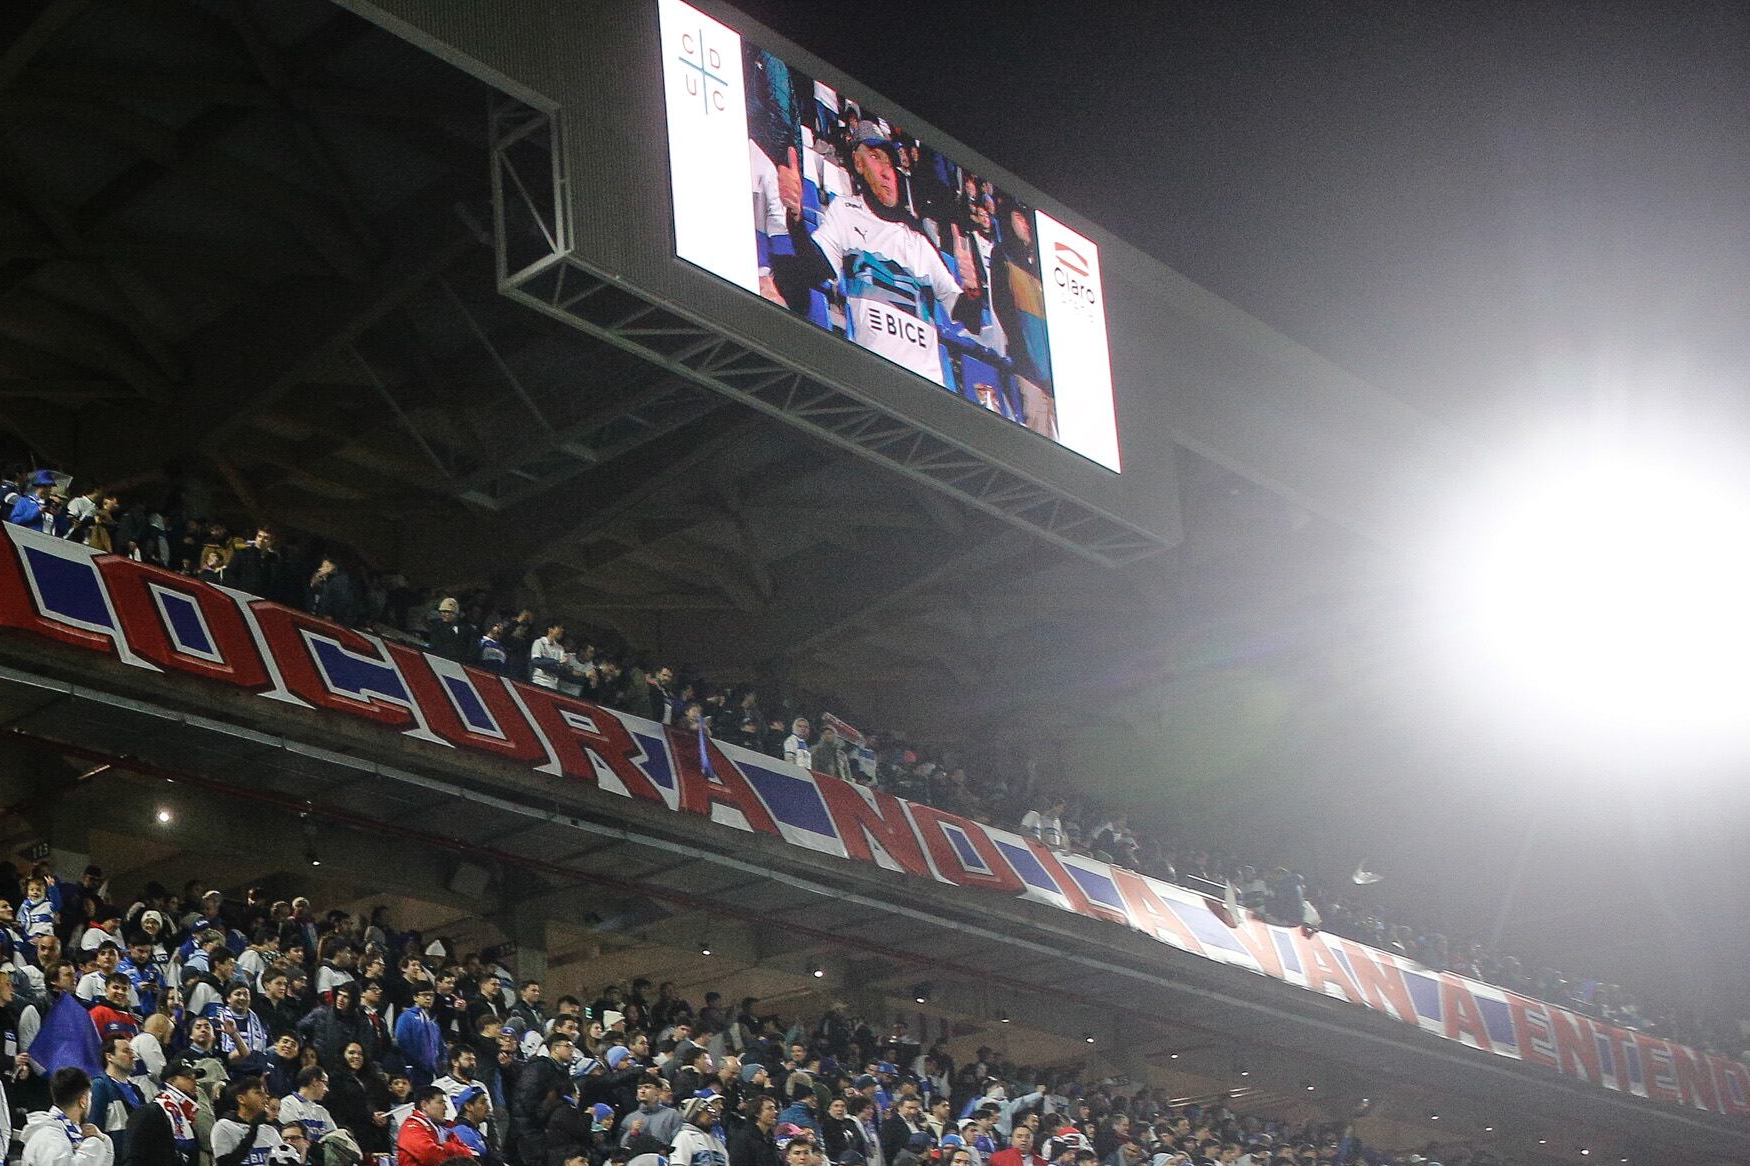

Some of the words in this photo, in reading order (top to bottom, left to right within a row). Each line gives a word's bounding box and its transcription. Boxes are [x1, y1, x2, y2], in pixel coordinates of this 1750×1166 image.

[1053, 267, 1095, 304] Claro
[885, 313, 927, 349] BICE
[809, 769, 1027, 898] NO
[1021, 836, 1205, 956] LA
[1203, 897, 1419, 1025] VAN
[1437, 970, 1493, 1051] A
